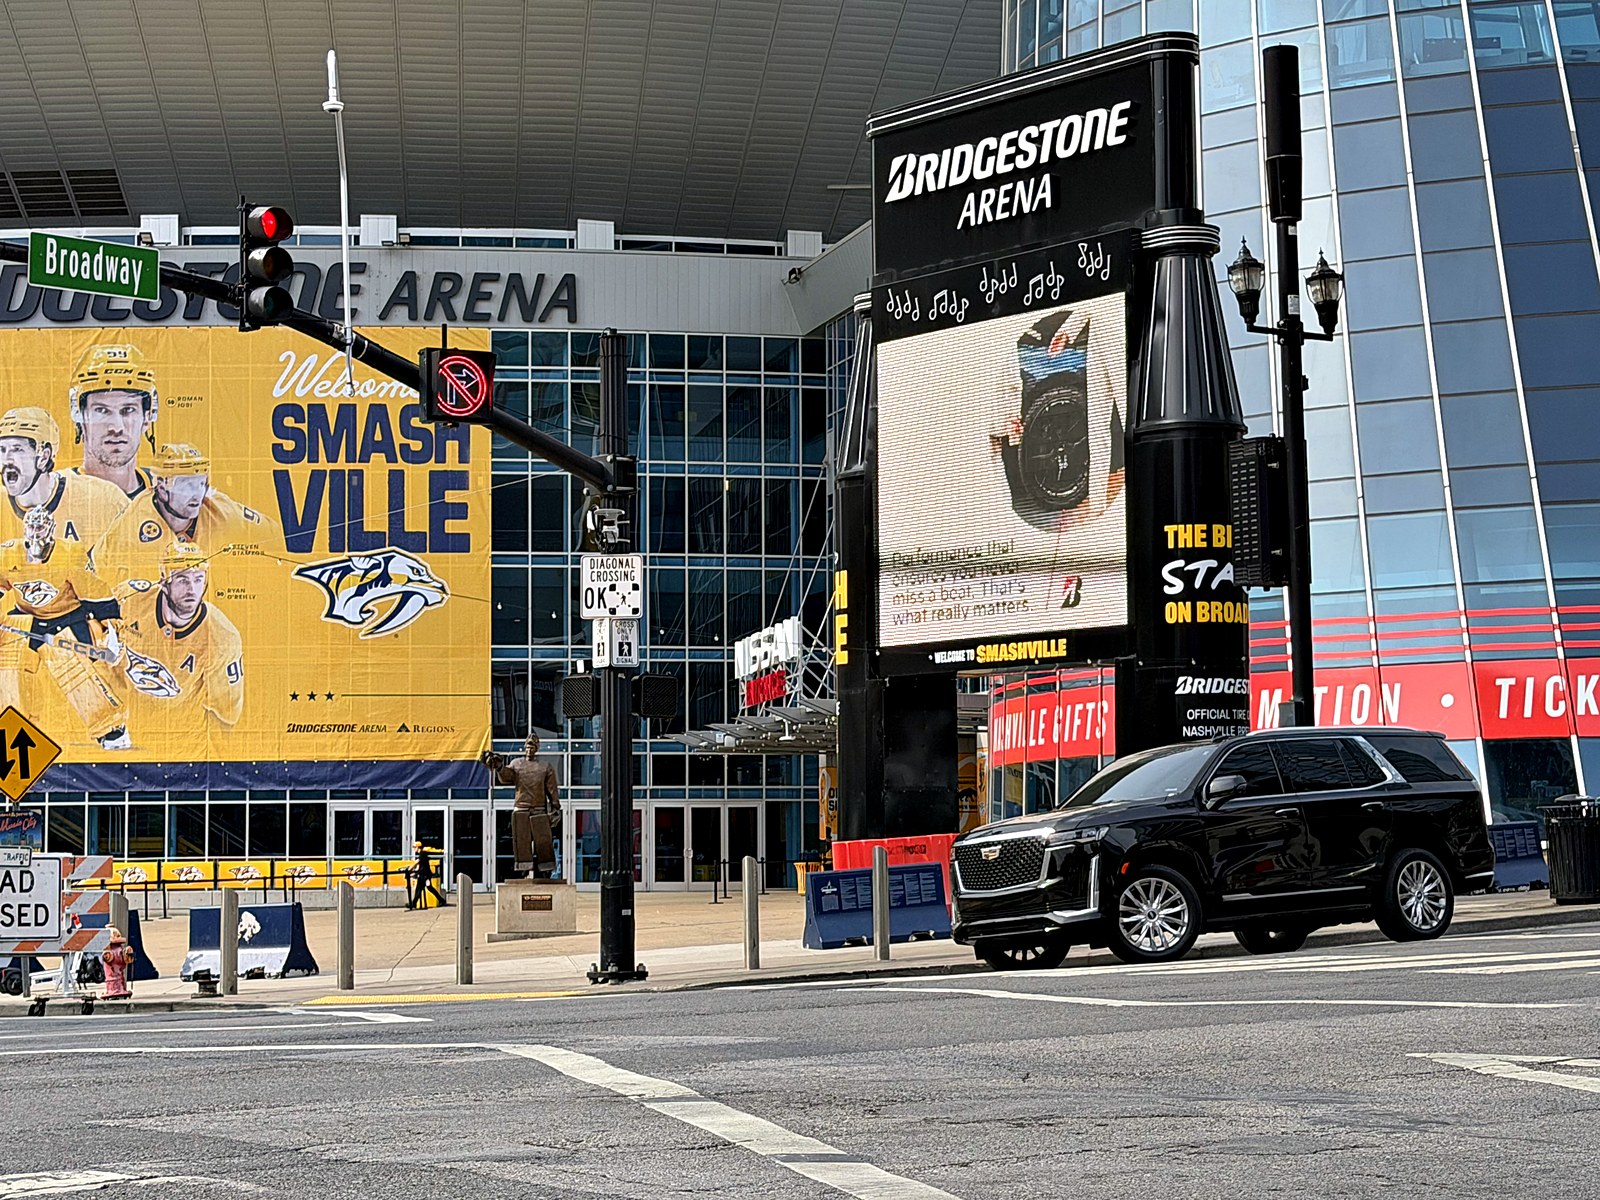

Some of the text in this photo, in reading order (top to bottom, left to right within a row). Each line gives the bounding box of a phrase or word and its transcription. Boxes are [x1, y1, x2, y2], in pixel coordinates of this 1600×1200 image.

[885, 101, 1131, 203] BRIDGESTONE
[956, 174, 1051, 230] ARENA
[45, 238, 143, 295] Broadway
[378, 270, 577, 323] ARENA
[271, 403, 470, 464] SMASH
[272, 469, 470, 553] VILLE
[64, 521, 79, 541] A
[1164, 524, 1207, 549] THE
[987, 538, 1015, 556] that
[590, 558, 636, 569] DIAGONAL
[590, 570, 635, 582] CROSSING
[585, 587, 607, 609] OK
[893, 589, 924, 605] miss
[929, 590, 936, 601] a
[980, 578, 1026, 595] That's
[893, 599, 1034, 625] what really matters.
[1165, 601, 1192, 624] ON
[58, 639, 106, 659] CCM
[934, 638, 1067, 664] WELCOME TO SMASHVILLE
[180, 654, 193, 673] A
[1186, 708, 1230, 720] OFFICIAL
[1232, 709, 1246, 720] TIRE
[1257, 674, 1600, 730] MTION TICK
[287, 723, 387, 733] BRIDGESTONE ARENA
[1052, 700, 1108, 744] GIFTS
[0, 903, 50, 928] SED
